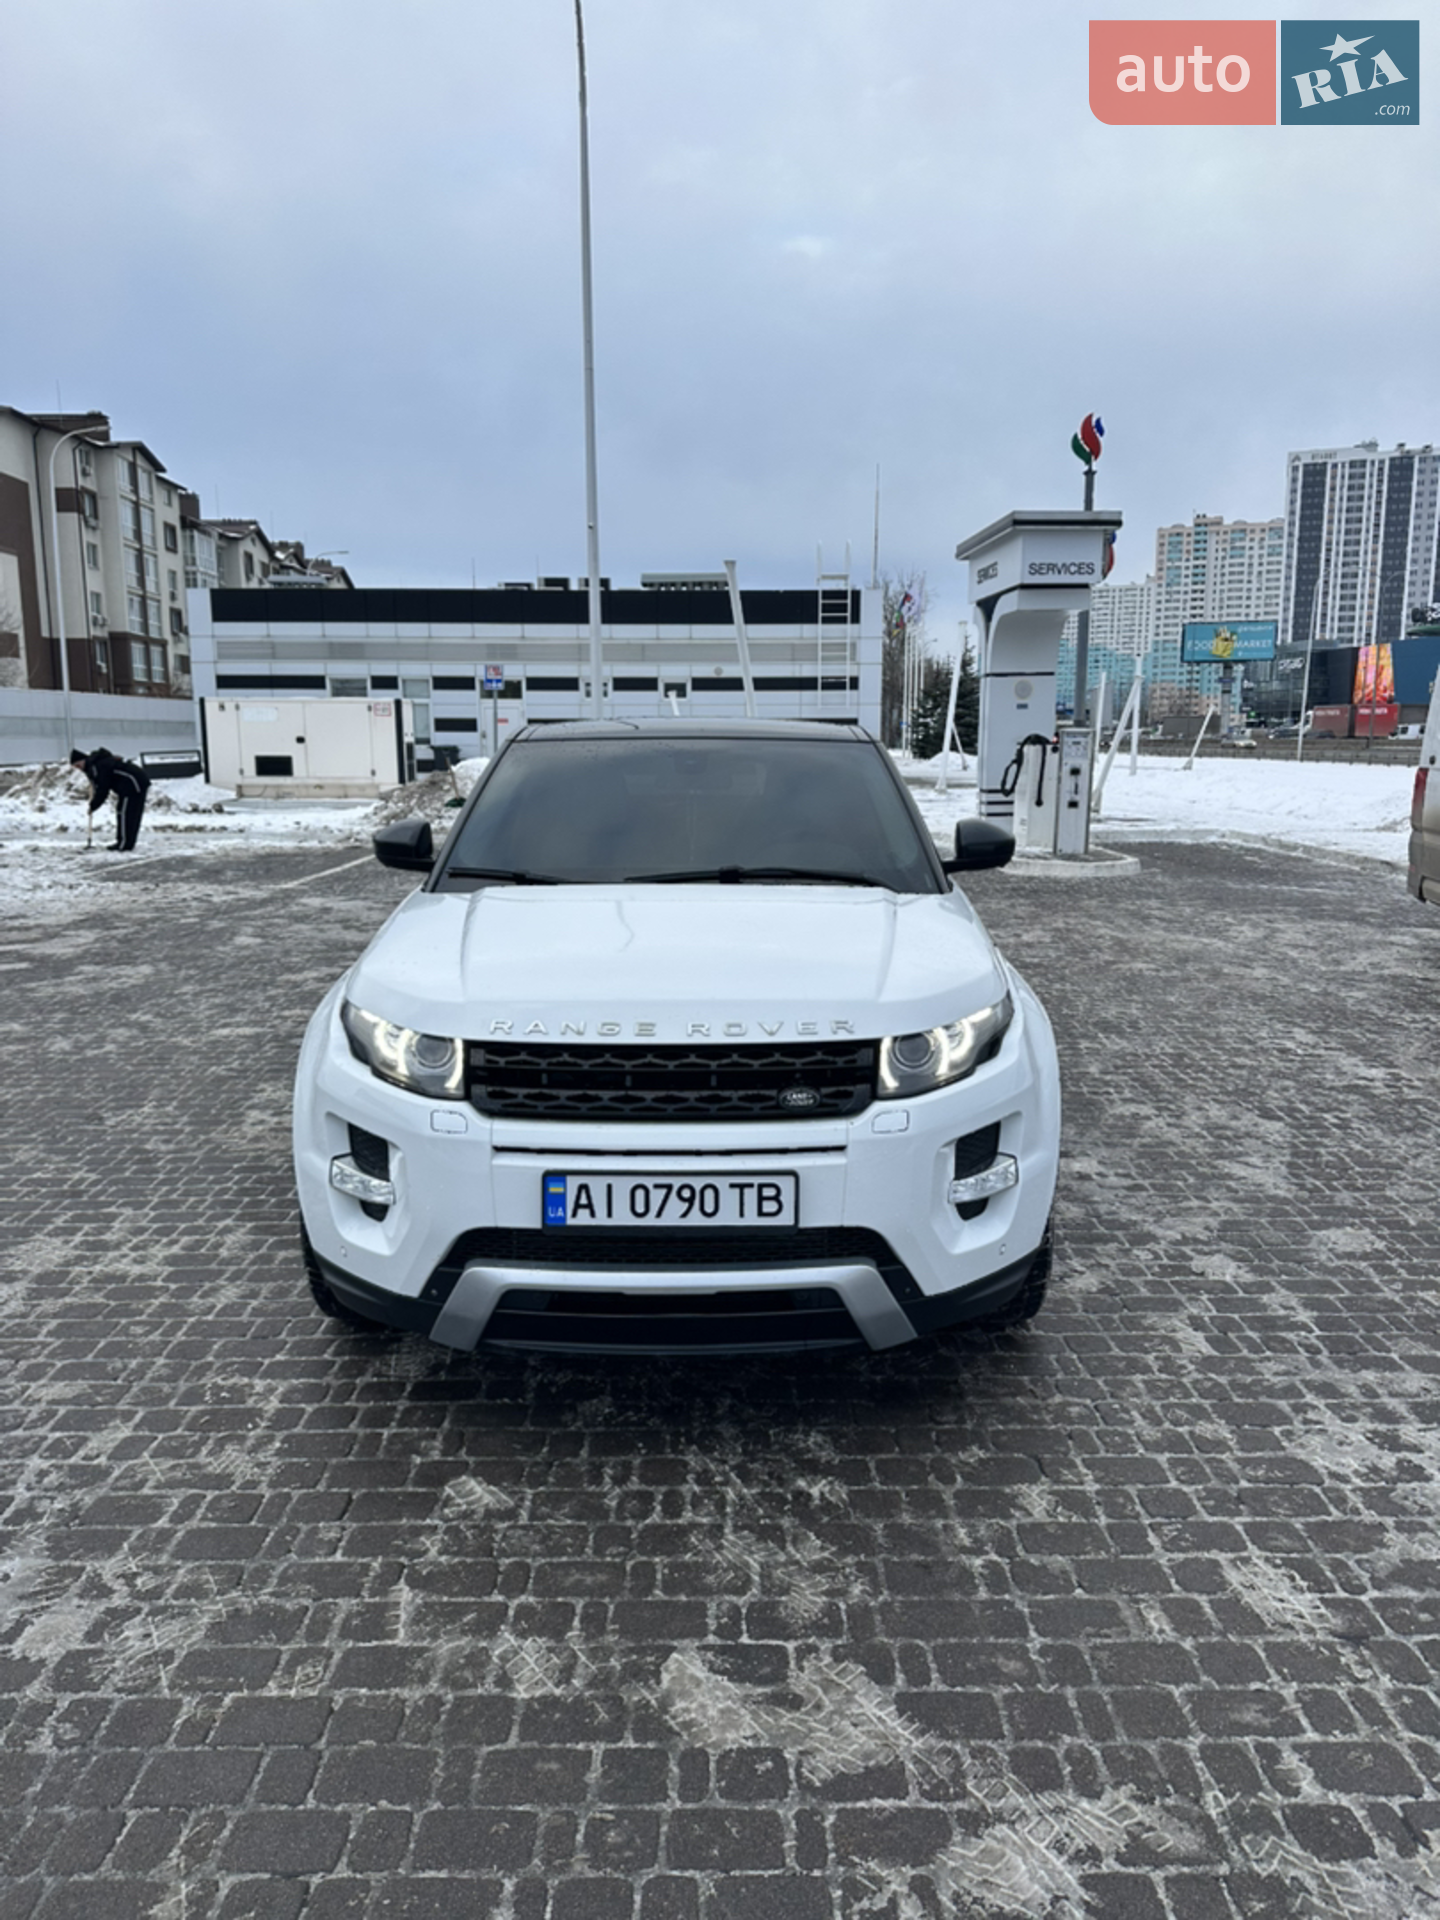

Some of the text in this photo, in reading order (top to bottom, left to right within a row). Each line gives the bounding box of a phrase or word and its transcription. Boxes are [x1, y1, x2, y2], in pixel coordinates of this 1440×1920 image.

[1027, 561, 1096, 576] SERVICES
[489, 1019, 856, 1038] RANGE ROVER
[570, 1182, 784, 1219] AI 0790 TB
[547, 1206, 565, 1218] UA
